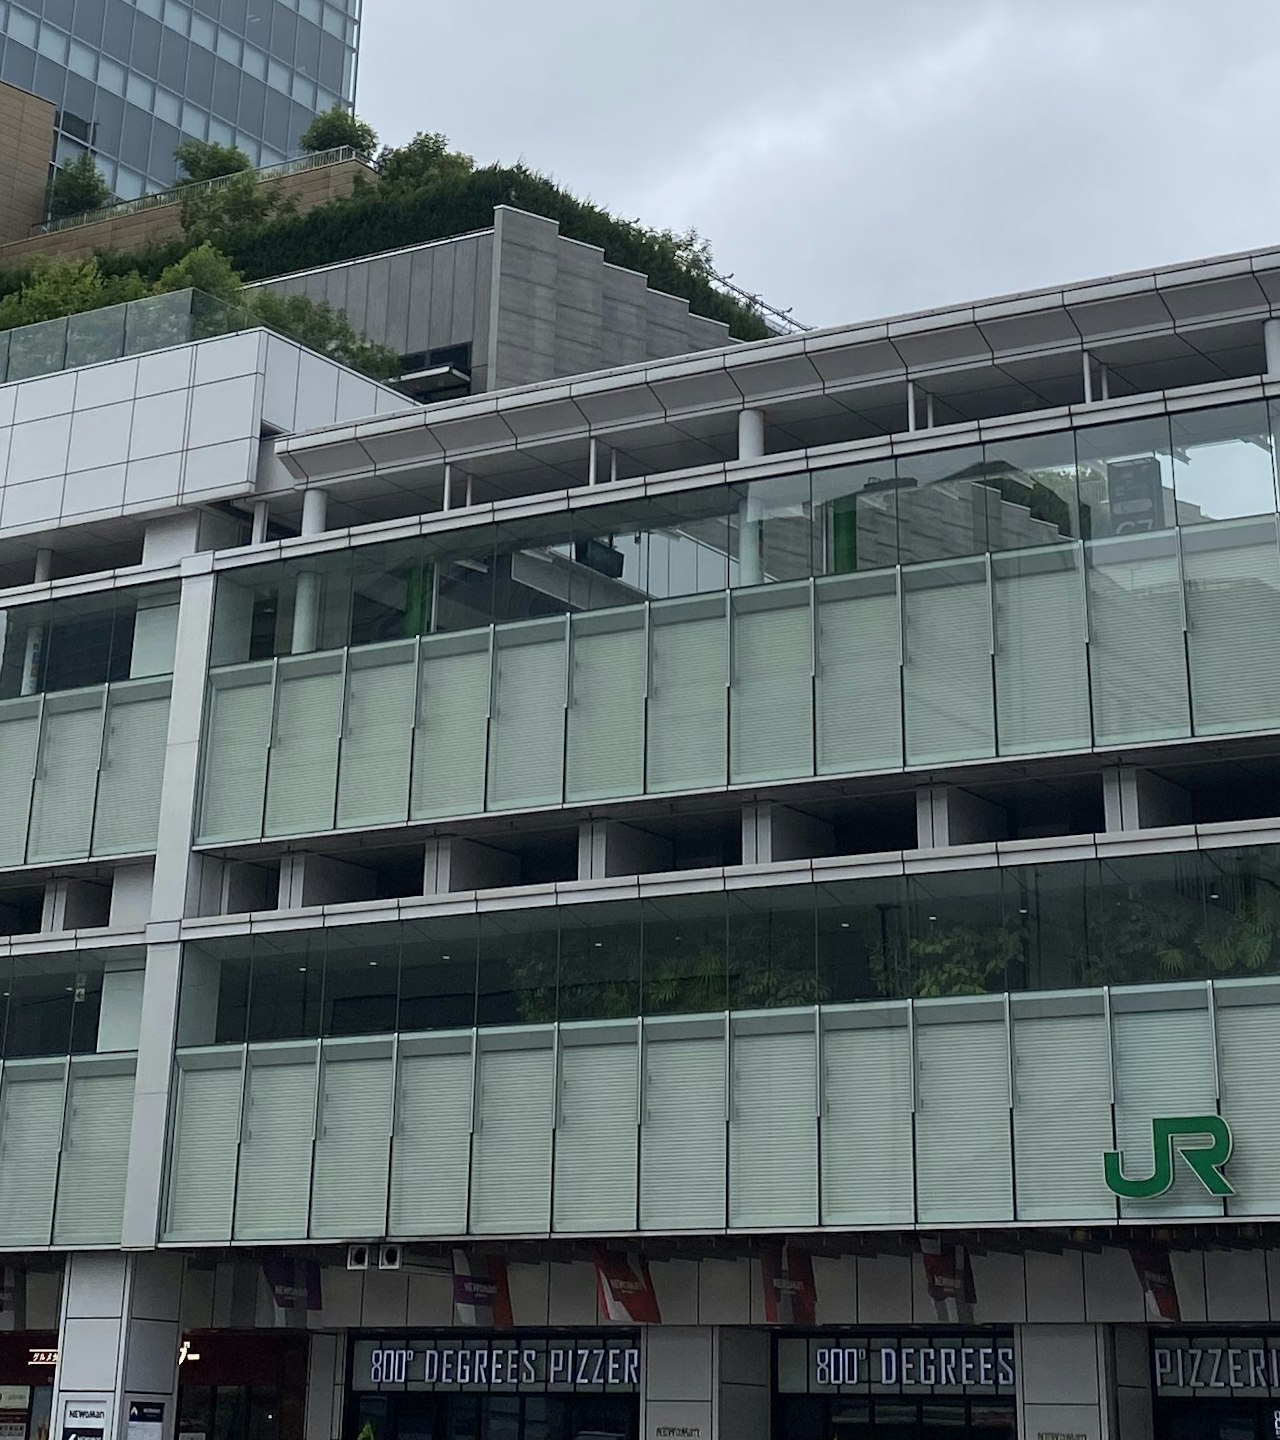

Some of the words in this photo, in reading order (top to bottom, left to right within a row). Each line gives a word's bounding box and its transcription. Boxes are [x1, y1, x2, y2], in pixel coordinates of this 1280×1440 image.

[1104, 1115, 1236, 1199] JR
[424, 1349, 535, 1383] DEGREES
[881, 1348, 1013, 1385] DEGREES
